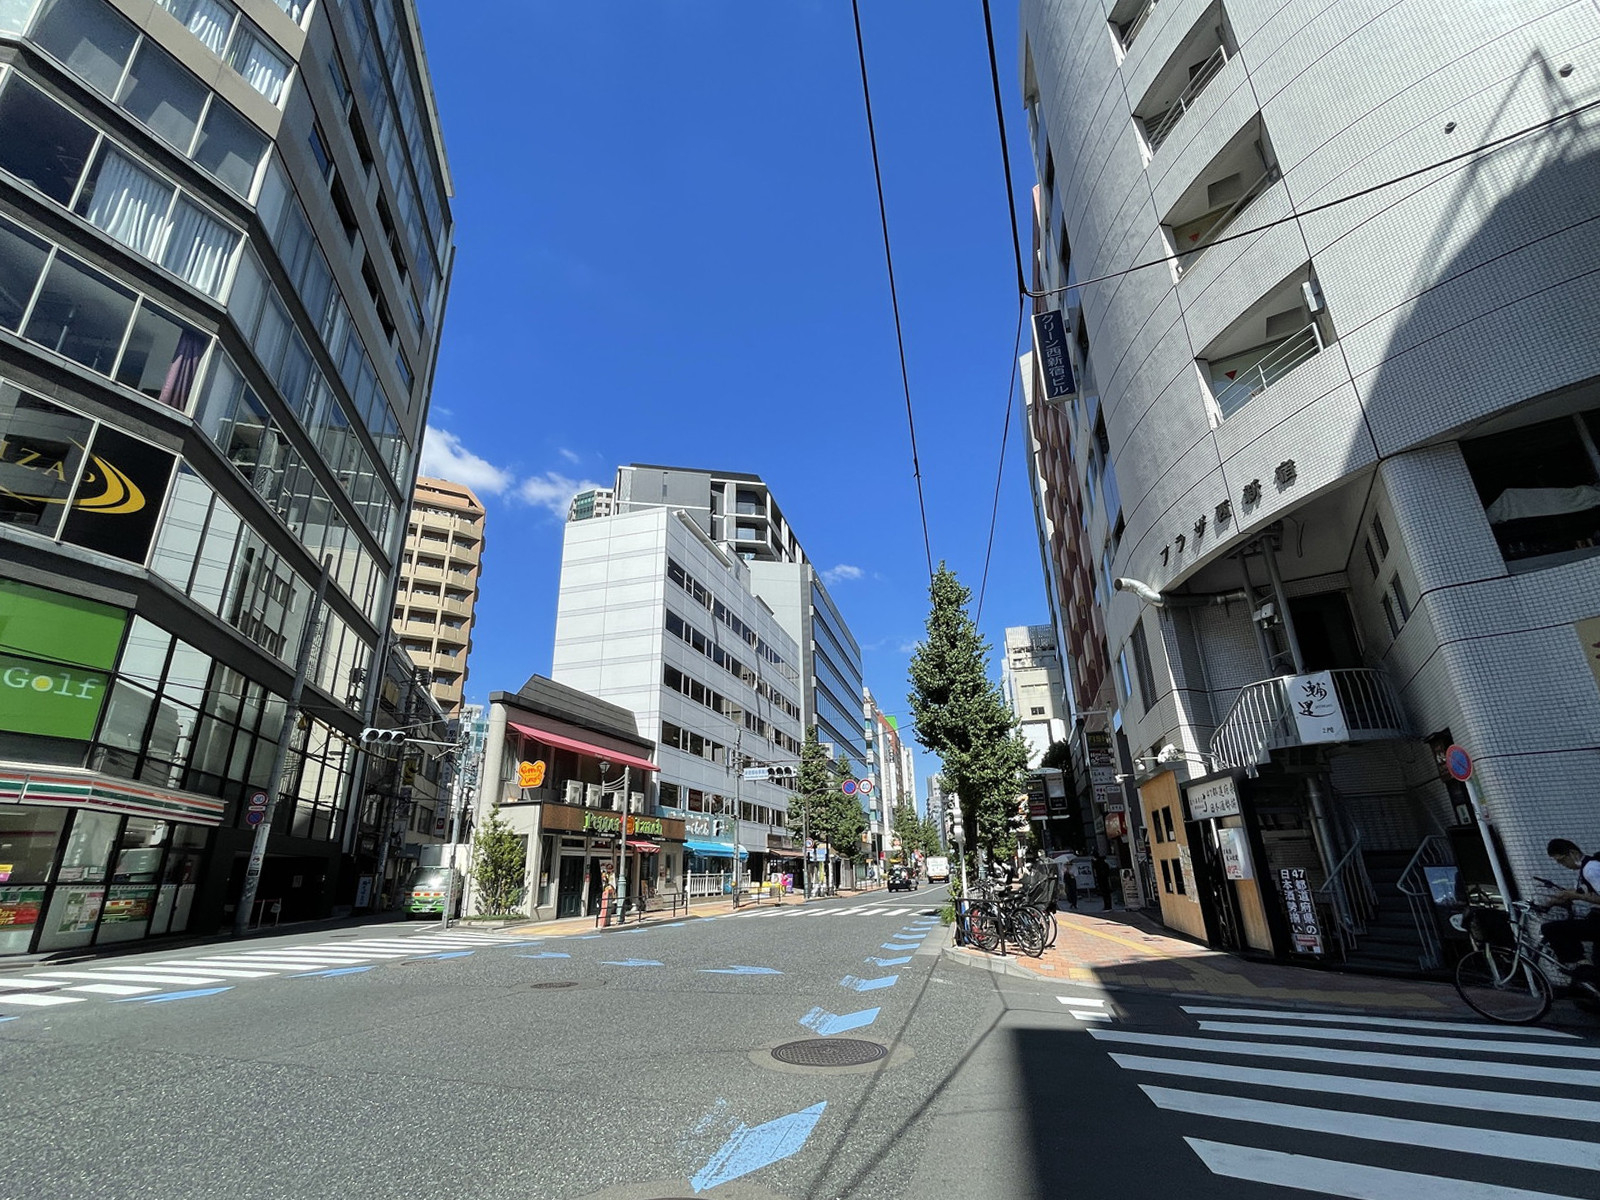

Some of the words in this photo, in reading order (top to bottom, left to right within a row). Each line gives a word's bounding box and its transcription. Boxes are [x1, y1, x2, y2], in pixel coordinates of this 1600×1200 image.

[1041, 314, 1069, 396] クリーン西新宿ビル
[1160, 458, 1297, 567] プラザ西新宿
[3, 667, 100, 699] Golf
[1291, 869, 1317, 935] 47都道府県の
